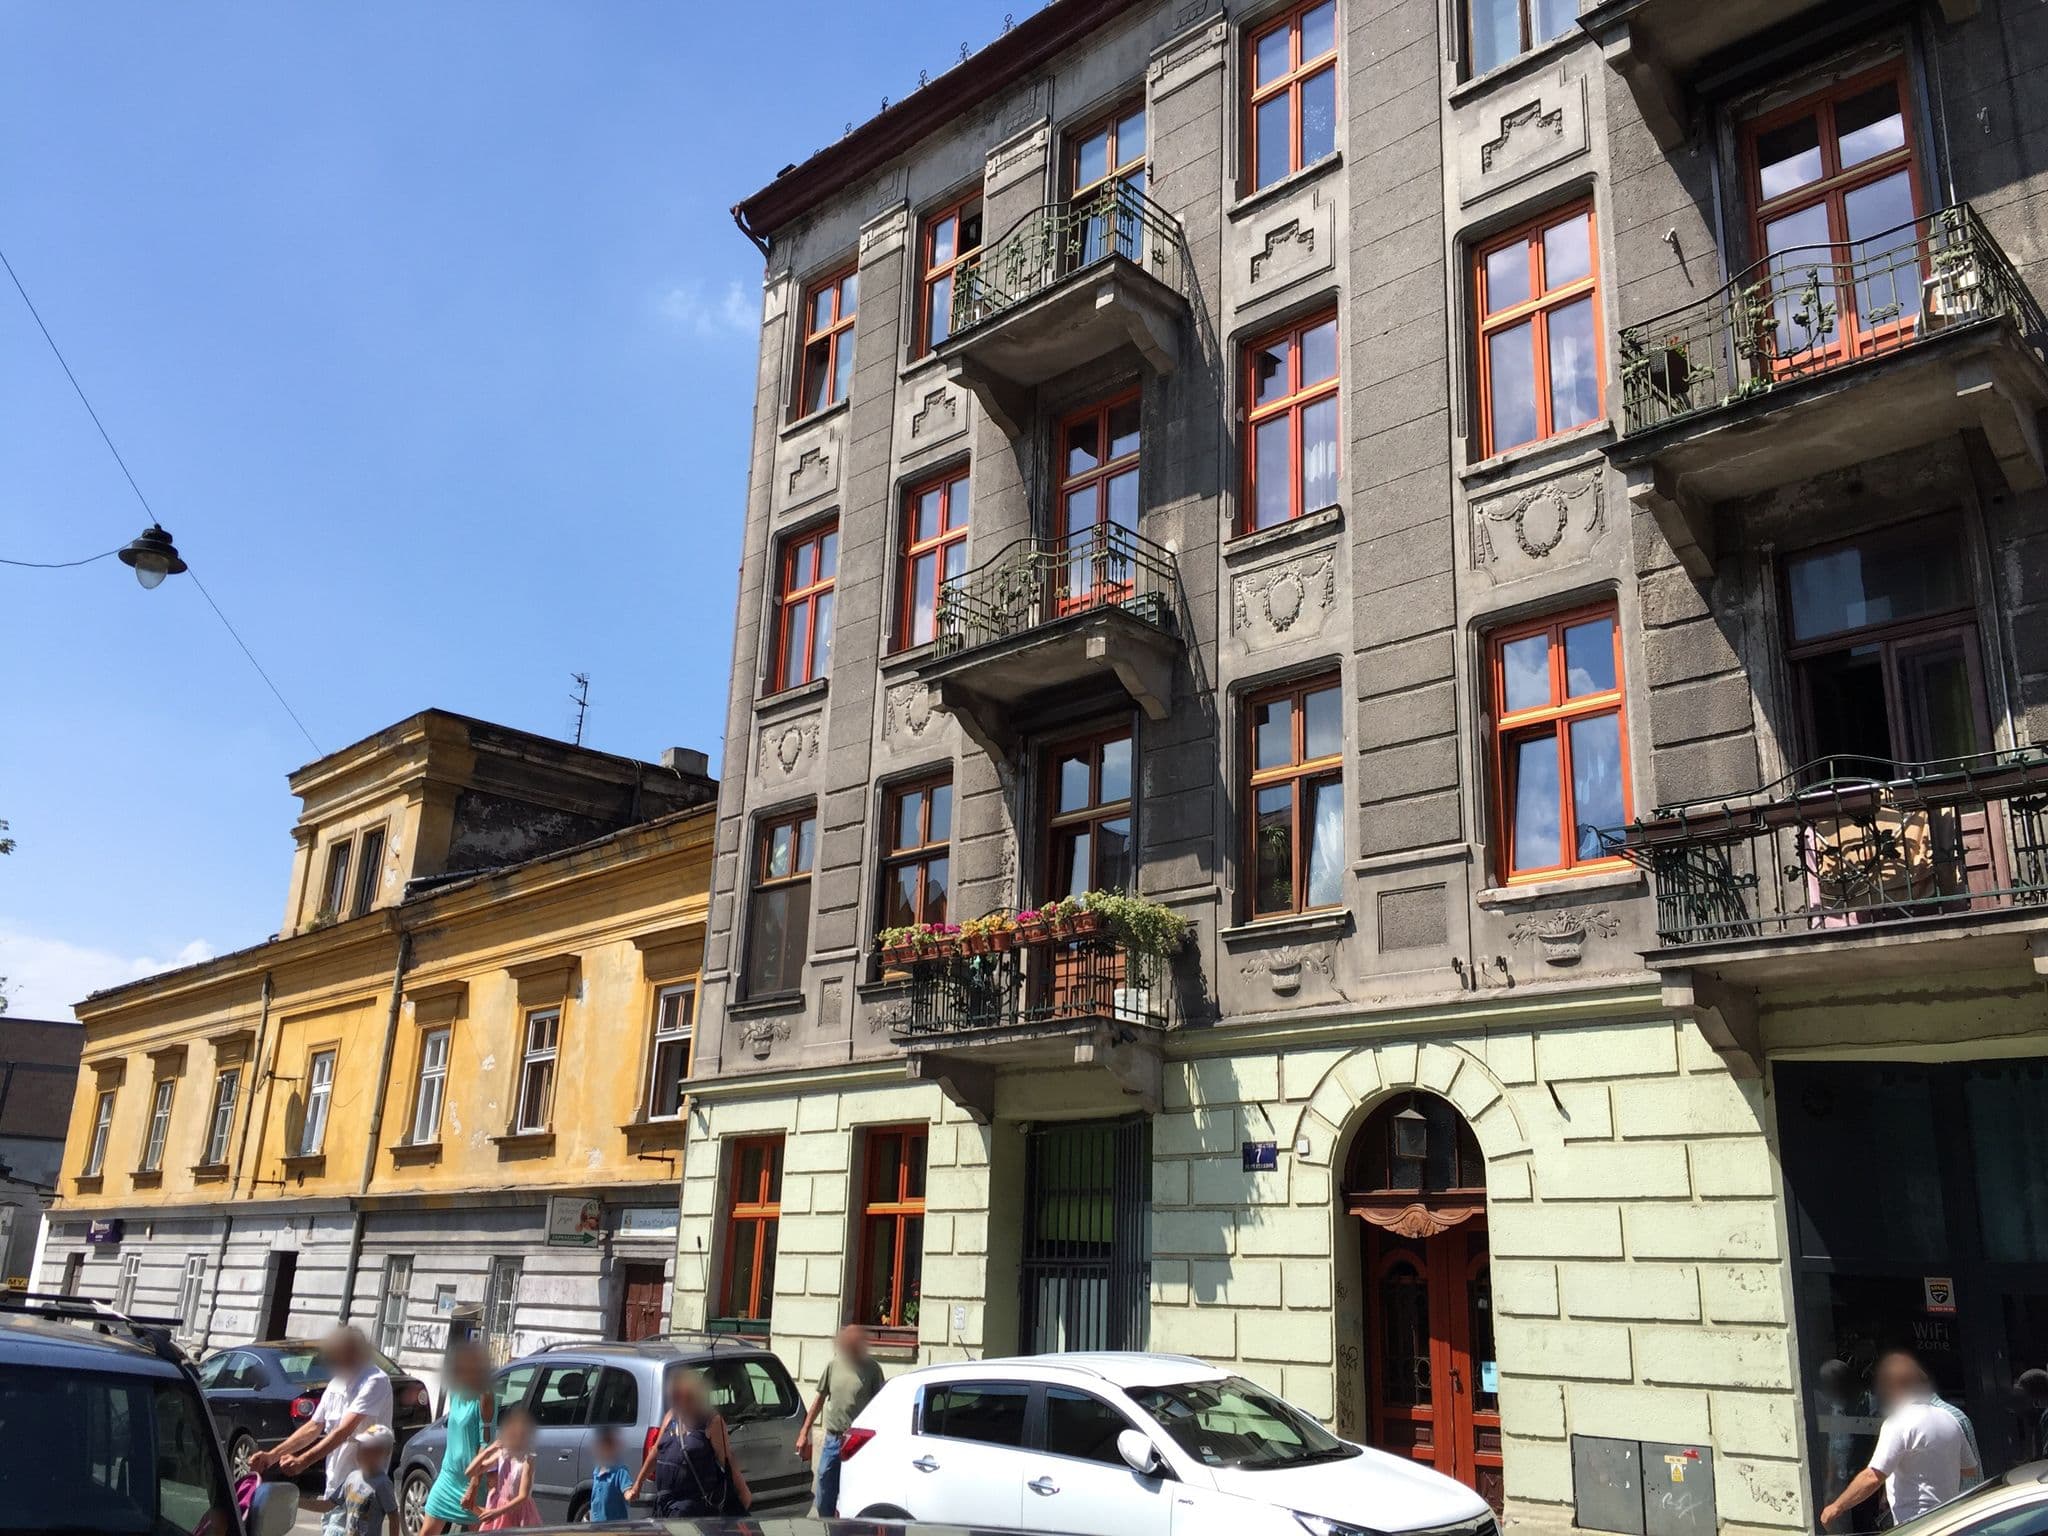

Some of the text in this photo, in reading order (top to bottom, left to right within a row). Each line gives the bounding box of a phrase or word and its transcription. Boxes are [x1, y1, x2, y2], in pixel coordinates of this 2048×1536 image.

[1254, 1148, 1262, 1164] 7
[1912, 1320, 1949, 1339] WiFi
[1918, 1340, 1950, 1351] zone
